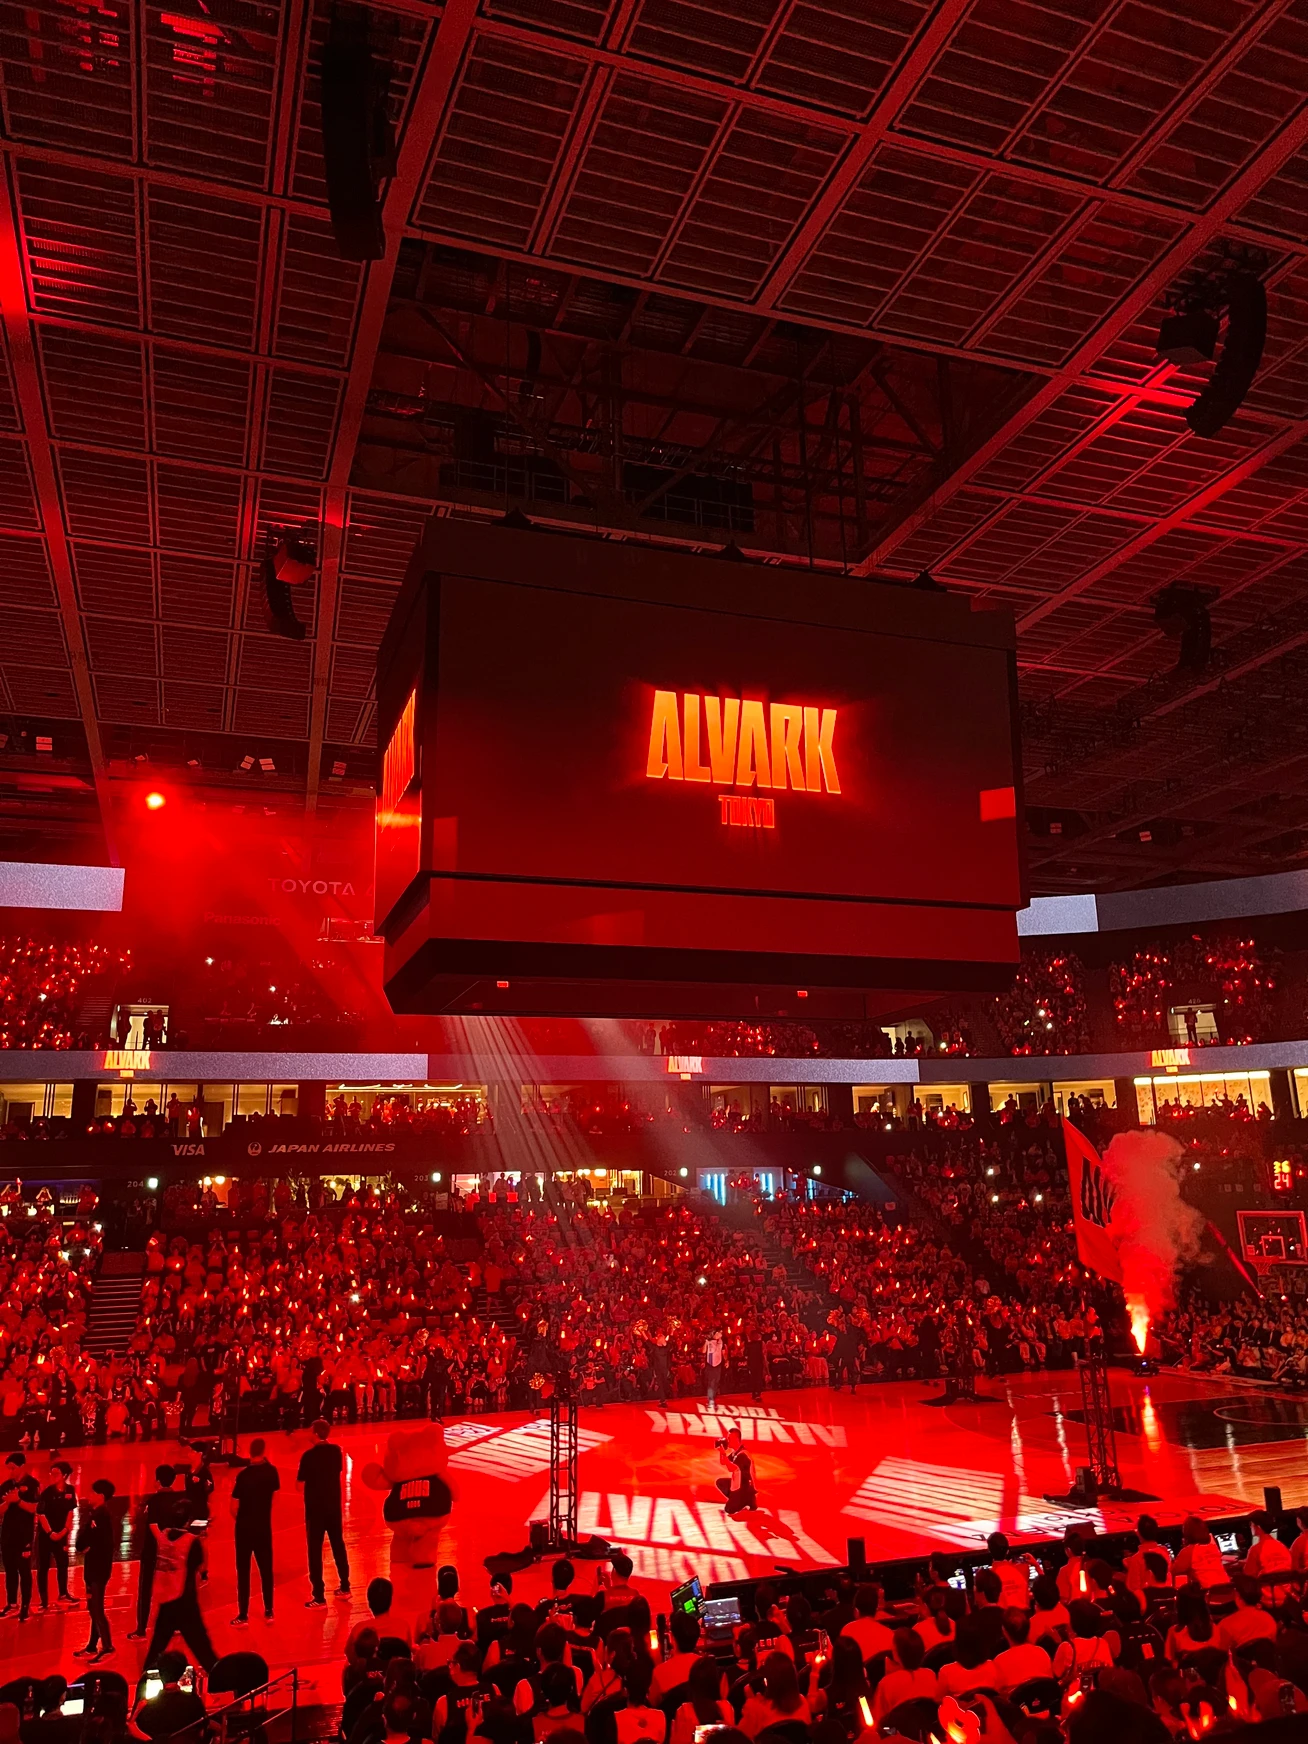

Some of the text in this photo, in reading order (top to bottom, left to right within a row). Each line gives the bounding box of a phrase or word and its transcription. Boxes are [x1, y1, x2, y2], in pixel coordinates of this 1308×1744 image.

[646, 689, 842, 794] ALVARK
[718, 794, 775, 829] TOKYO
[267, 878, 356, 896] TOYOTA
[203, 911, 281, 926] Panasonic
[103, 1050, 151, 1070] ALVARK
[170, 1143, 206, 1156] VISA
[267, 1143, 396, 1153] JAPAN AIRLINES
[1273, 1160, 1291, 1174] 36
[127, 1180, 144, 1188] 204
[414, 1174, 429, 1182] 203
[1273, 1173, 1290, 1190] 24
